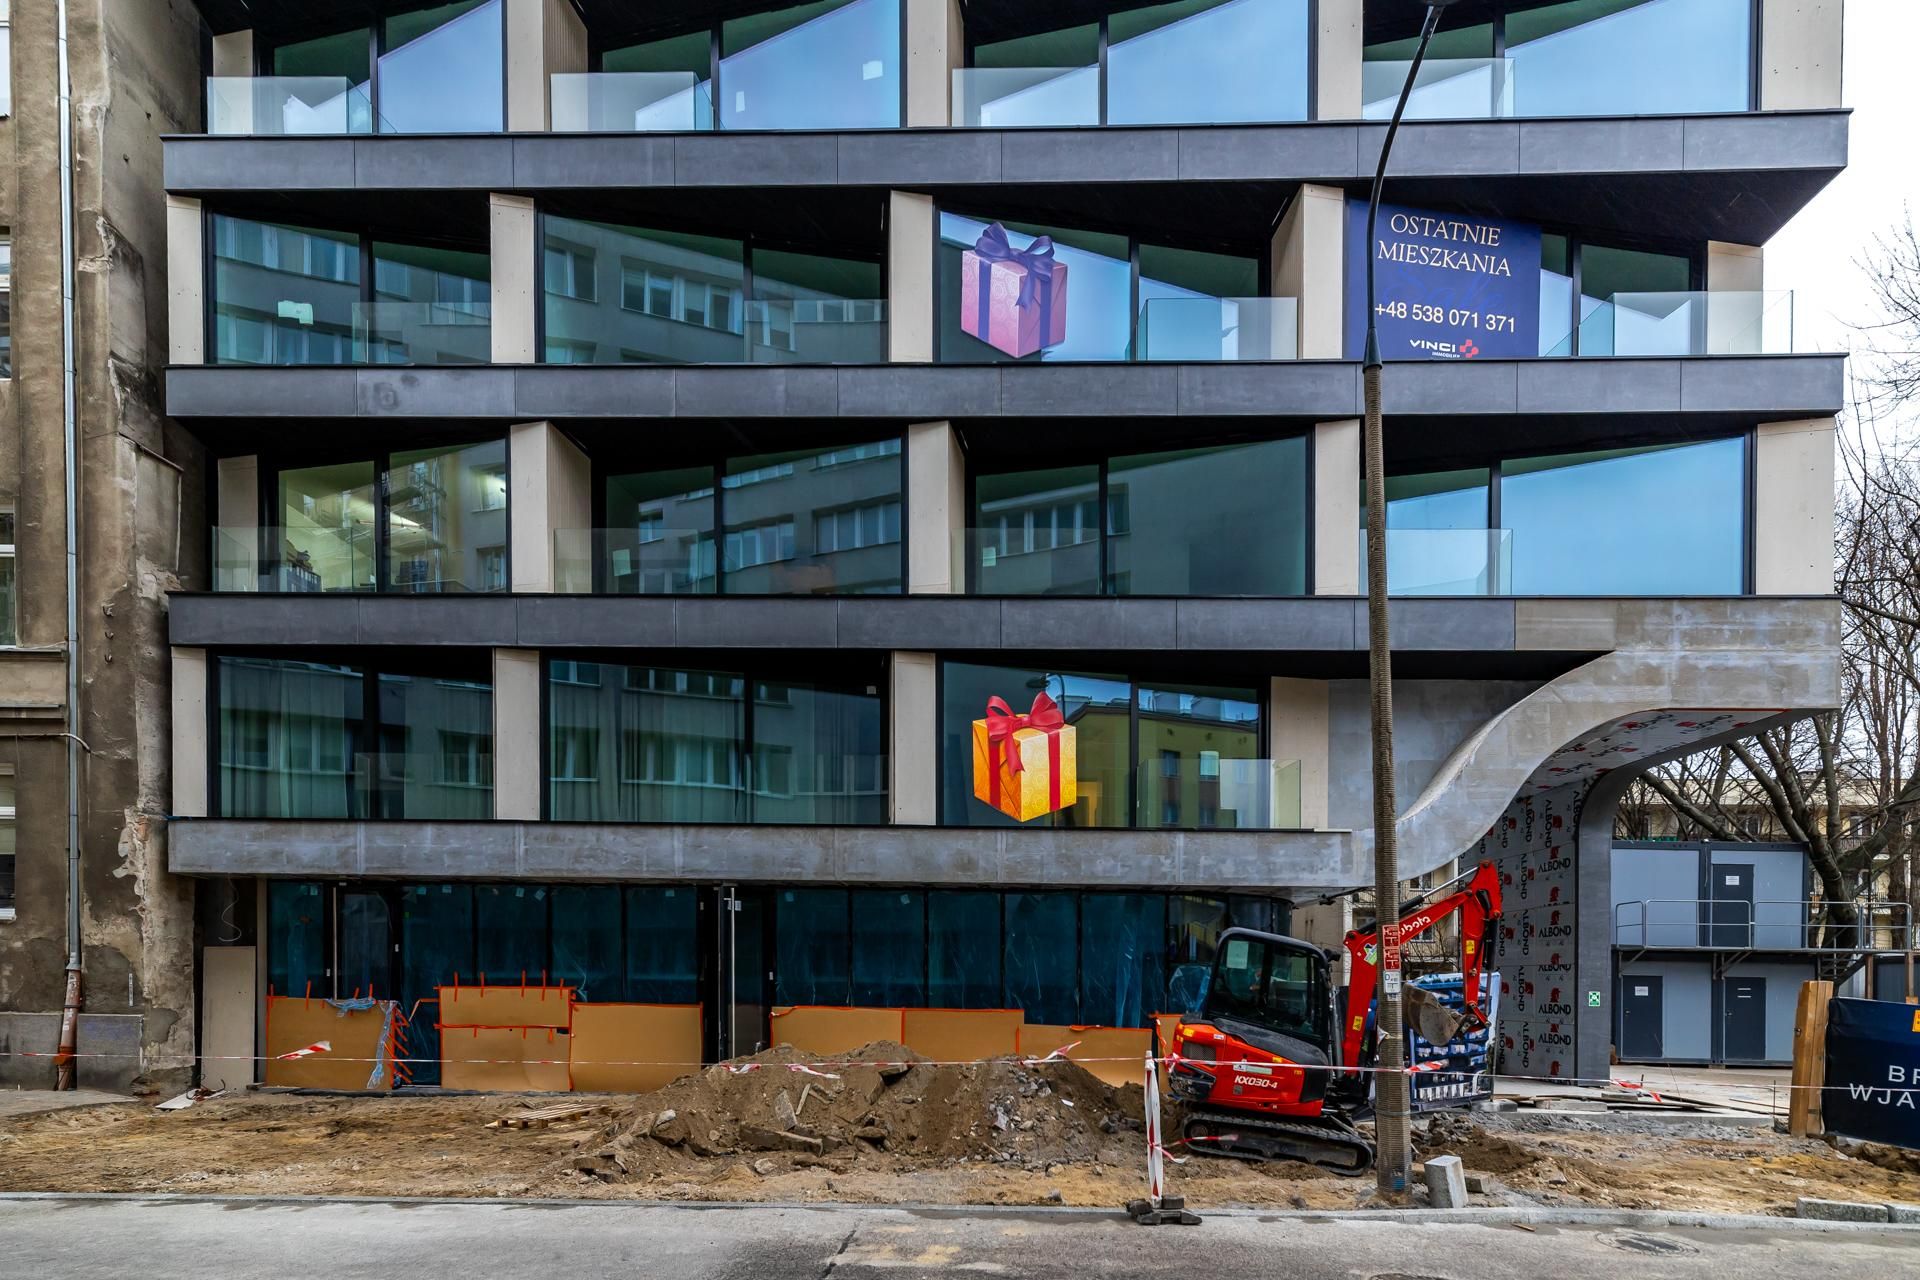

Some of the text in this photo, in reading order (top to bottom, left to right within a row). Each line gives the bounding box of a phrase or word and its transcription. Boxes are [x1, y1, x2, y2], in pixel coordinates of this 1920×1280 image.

[1390, 213, 1501, 247] OSTATNIE
[1377, 240, 1512, 277] MIESZKANIA
[1375, 300, 1516, 333] +48 538 071 371
[1409, 339, 1456, 353] VINCI
[1544, 799, 1553, 848] ALBOND
[1520, 853, 1529, 900] ALBOND
[1537, 857, 1572, 873] ALBOND
[1399, 916, 1432, 936] ubota
[1522, 909, 1530, 956] ALBOND
[1538, 925, 1572, 938] ALBOND
[1518, 965, 1526, 1012] ALBOND
[1538, 1003, 1572, 1015] ALBOND
[1522, 1021, 1530, 1069] ALBOND
[1538, 1033, 1572, 1046] ALBOND
[1234, 1074, 1279, 1089] KX030-4
